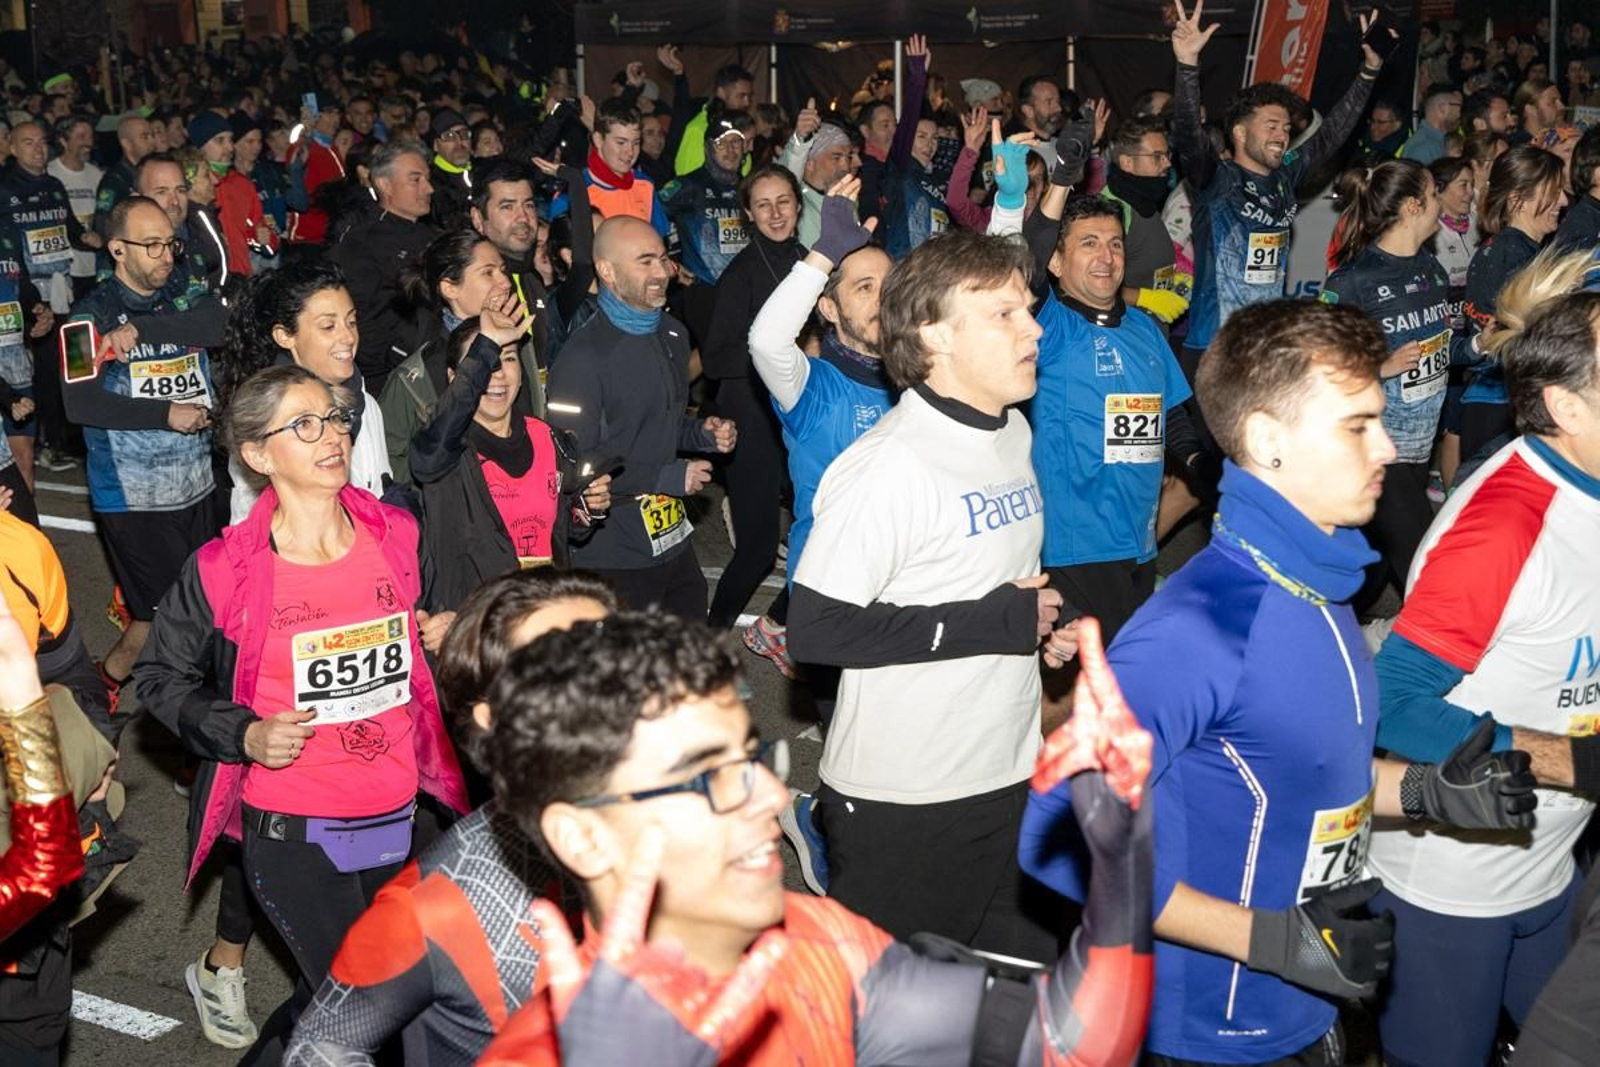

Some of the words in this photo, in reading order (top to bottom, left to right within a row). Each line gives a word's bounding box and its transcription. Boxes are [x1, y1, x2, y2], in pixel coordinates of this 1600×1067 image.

[13, 211, 37, 223] SAN
[705, 208, 728, 219] SAN
[1241, 202, 1273, 226] SAN
[1382, 311, 1421, 334] SAN
[139, 372, 201, 397] 4894
[322, 632, 346, 651] 42
[307, 642, 404, 690] 6518
